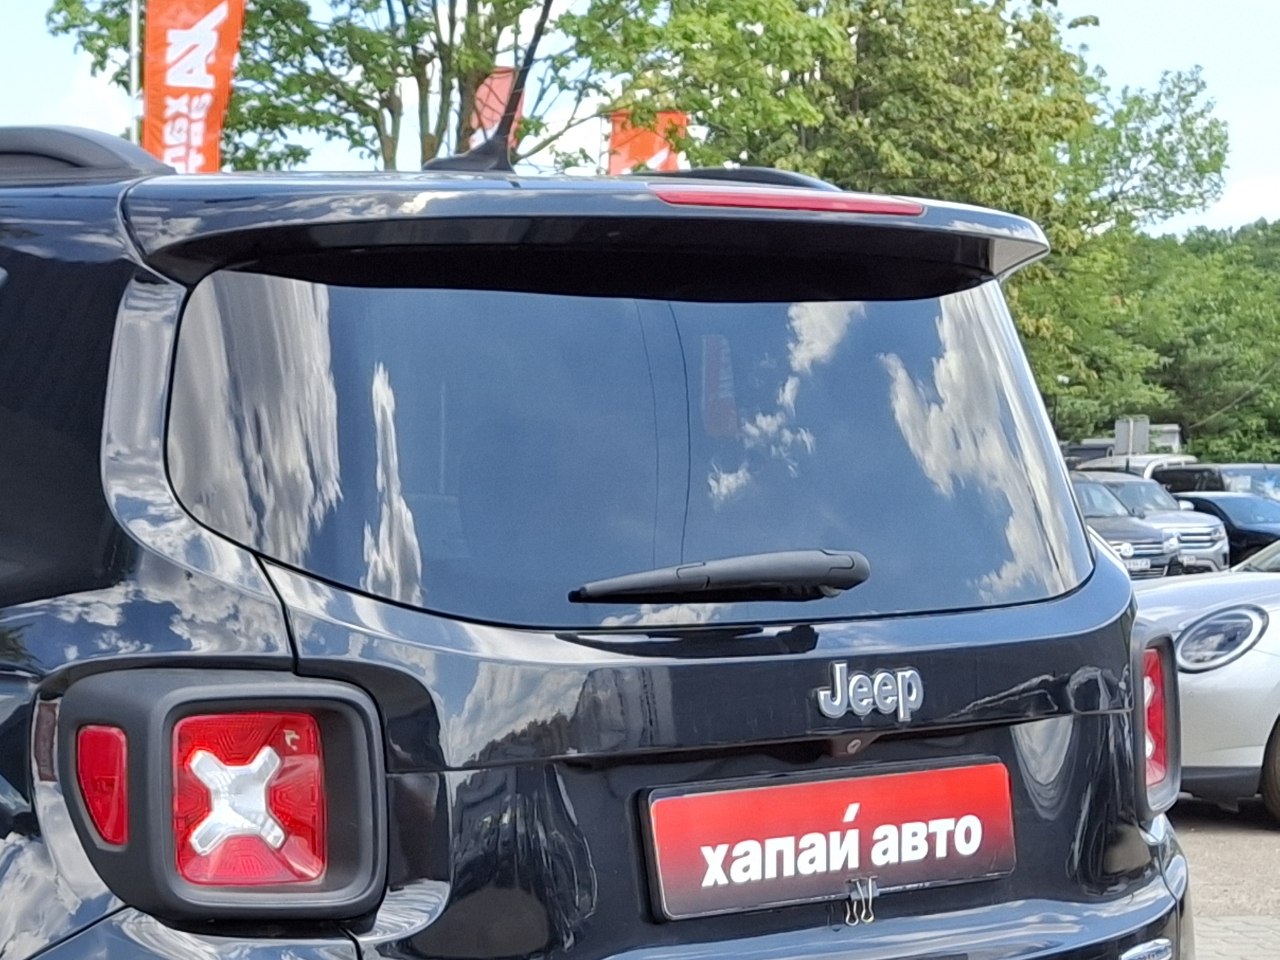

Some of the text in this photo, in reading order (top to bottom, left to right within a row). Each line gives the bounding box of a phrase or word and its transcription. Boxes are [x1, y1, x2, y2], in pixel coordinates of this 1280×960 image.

[816, 661, 924, 722] Jeep
[700, 802, 983, 888] хапай авто
